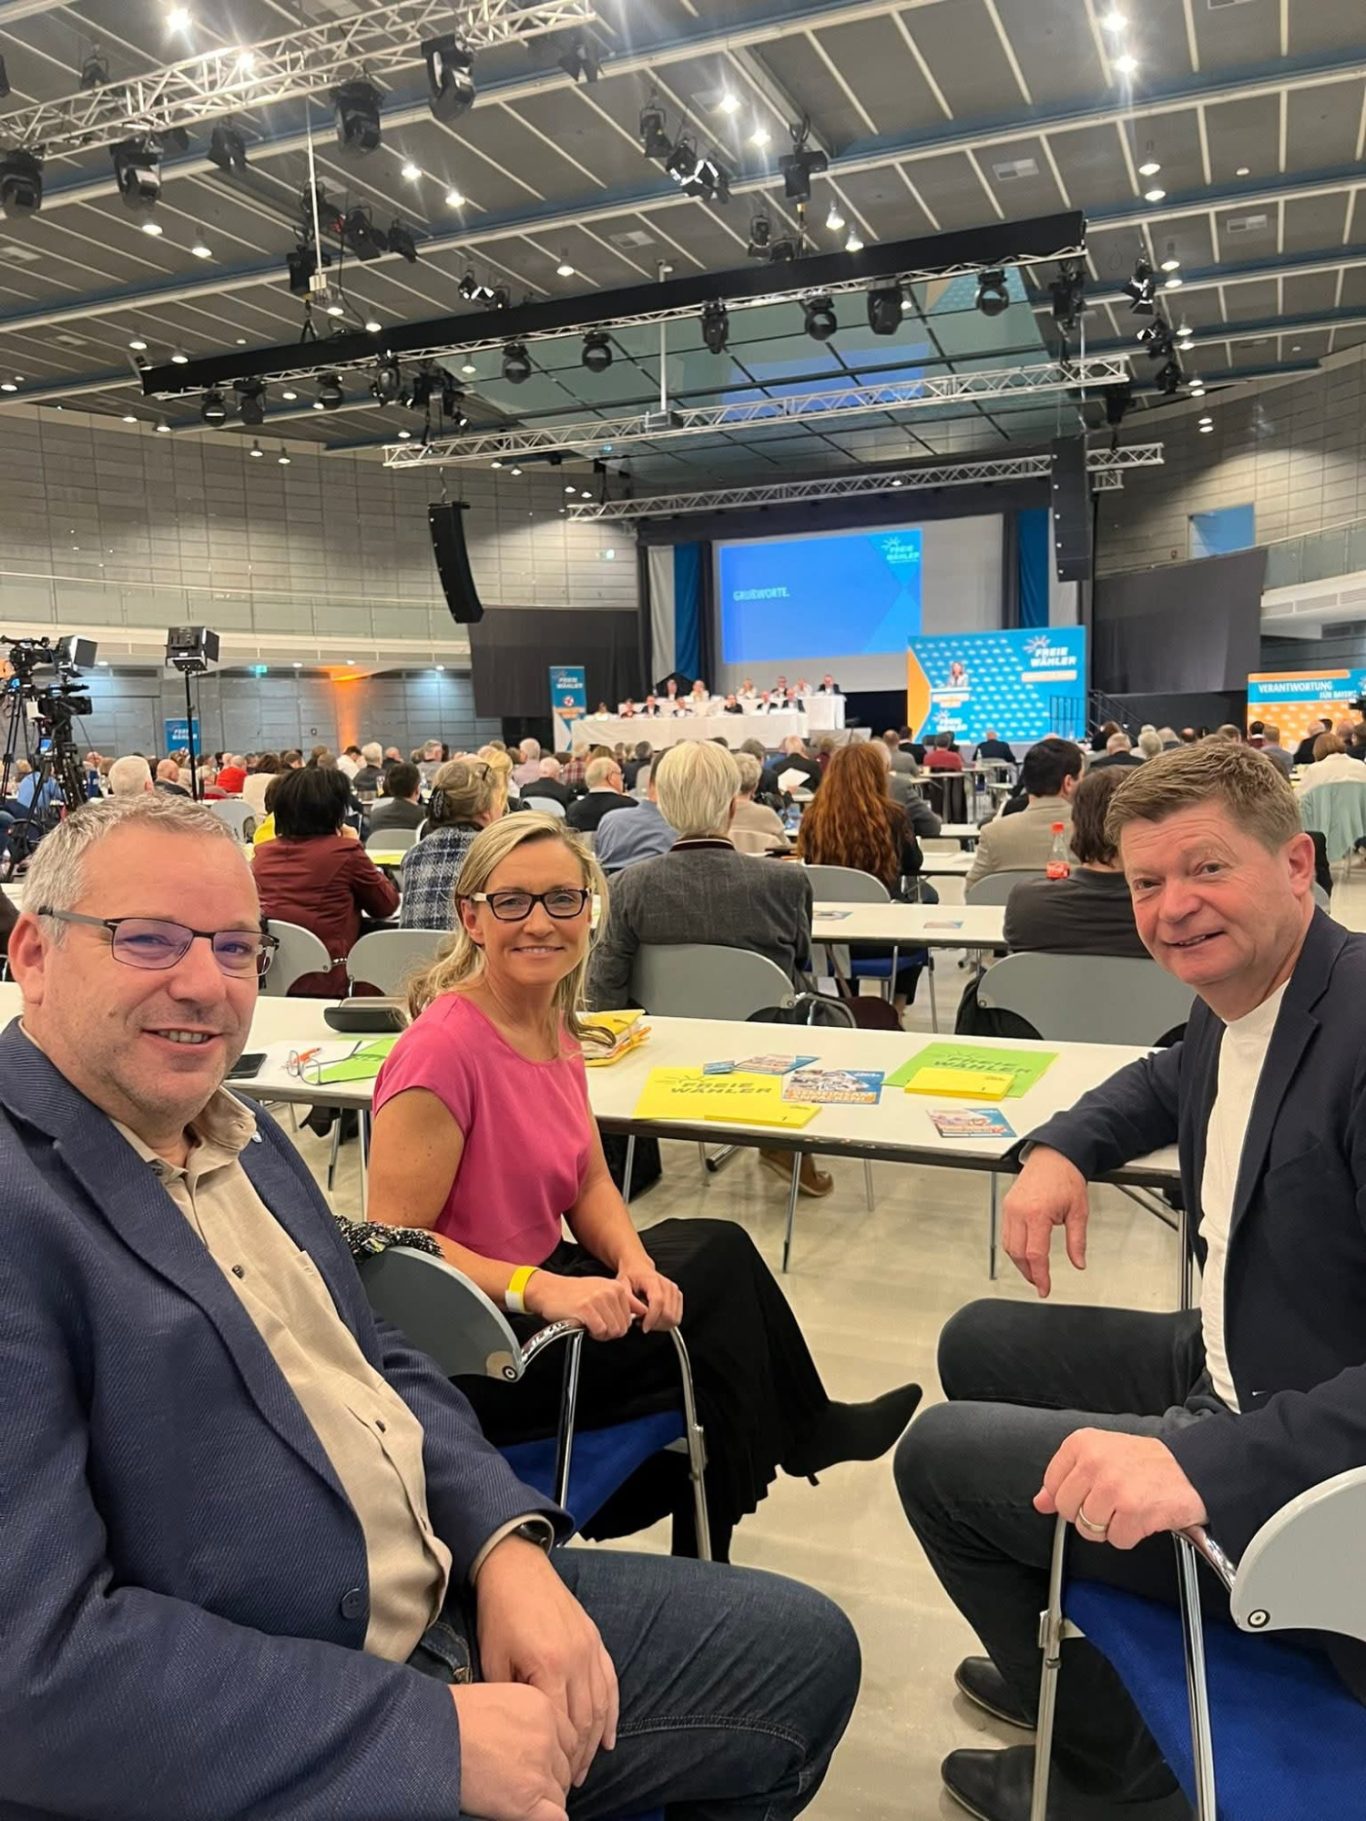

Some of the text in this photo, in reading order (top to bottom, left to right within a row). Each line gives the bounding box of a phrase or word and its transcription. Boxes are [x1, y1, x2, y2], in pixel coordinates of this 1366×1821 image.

[1035, 647, 1069, 657] FREIE
[1258, 681, 1333, 693] VERANTWORTUNG
[947, 1056, 1019, 1067] FREIE
